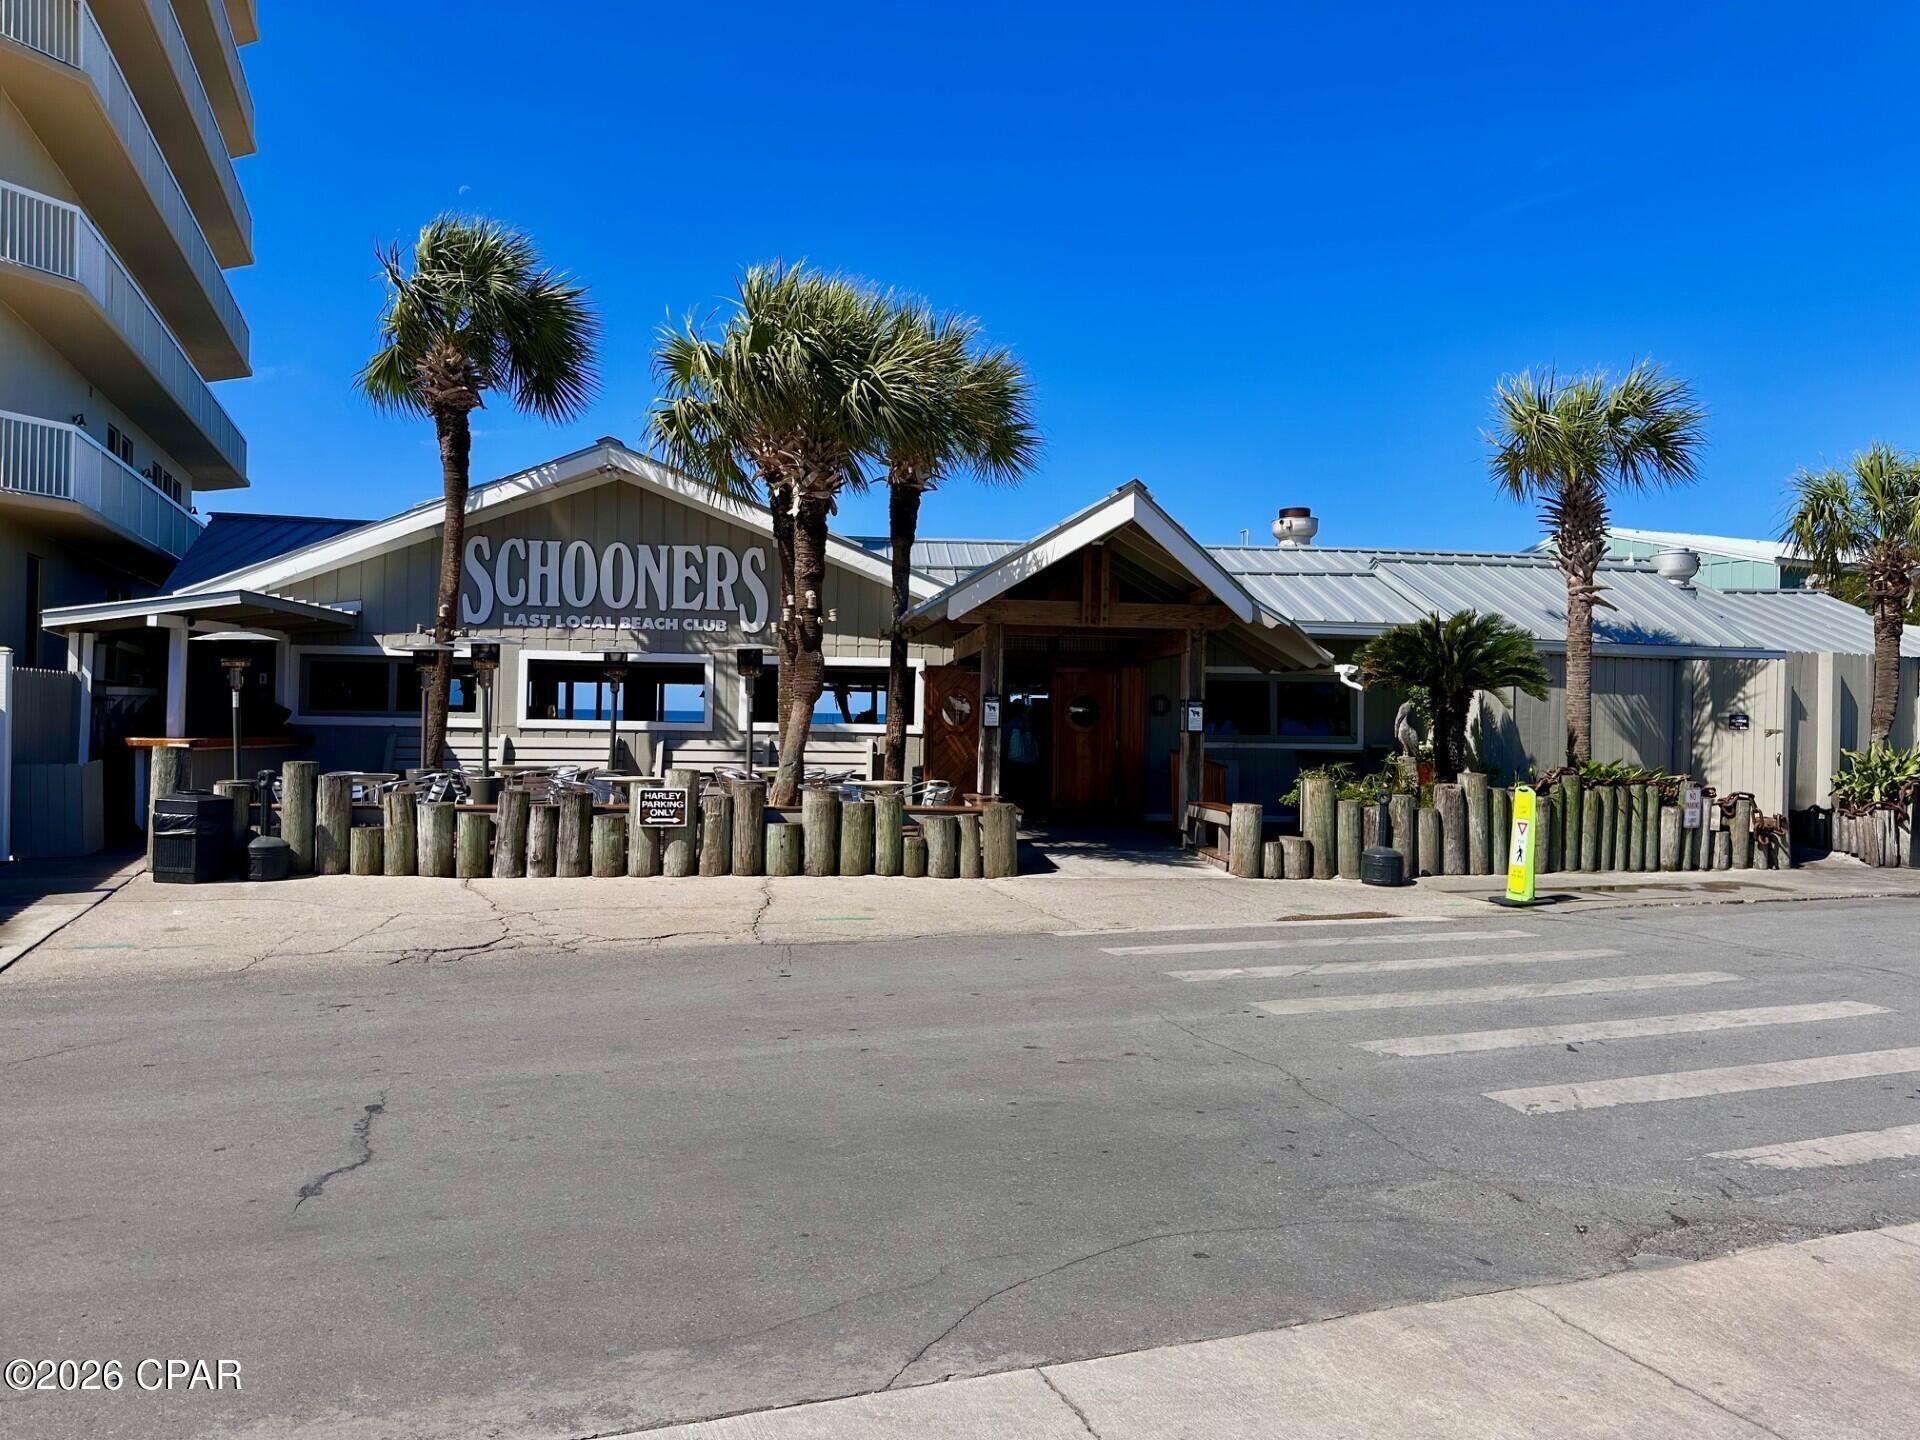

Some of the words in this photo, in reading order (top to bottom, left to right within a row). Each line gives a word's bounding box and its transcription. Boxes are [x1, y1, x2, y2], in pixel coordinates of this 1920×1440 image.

[462, 535, 769, 634] SCHOONERS
[503, 612, 550, 627] LAST
[555, 614, 616, 629] LOCAL
[619, 617, 678, 631] BEACH
[683, 619, 728, 632] CLUB
[644, 792, 681, 800] HARLEY
[641, 800, 684, 808] PARKING
[650, 808, 675, 817] ONLY
